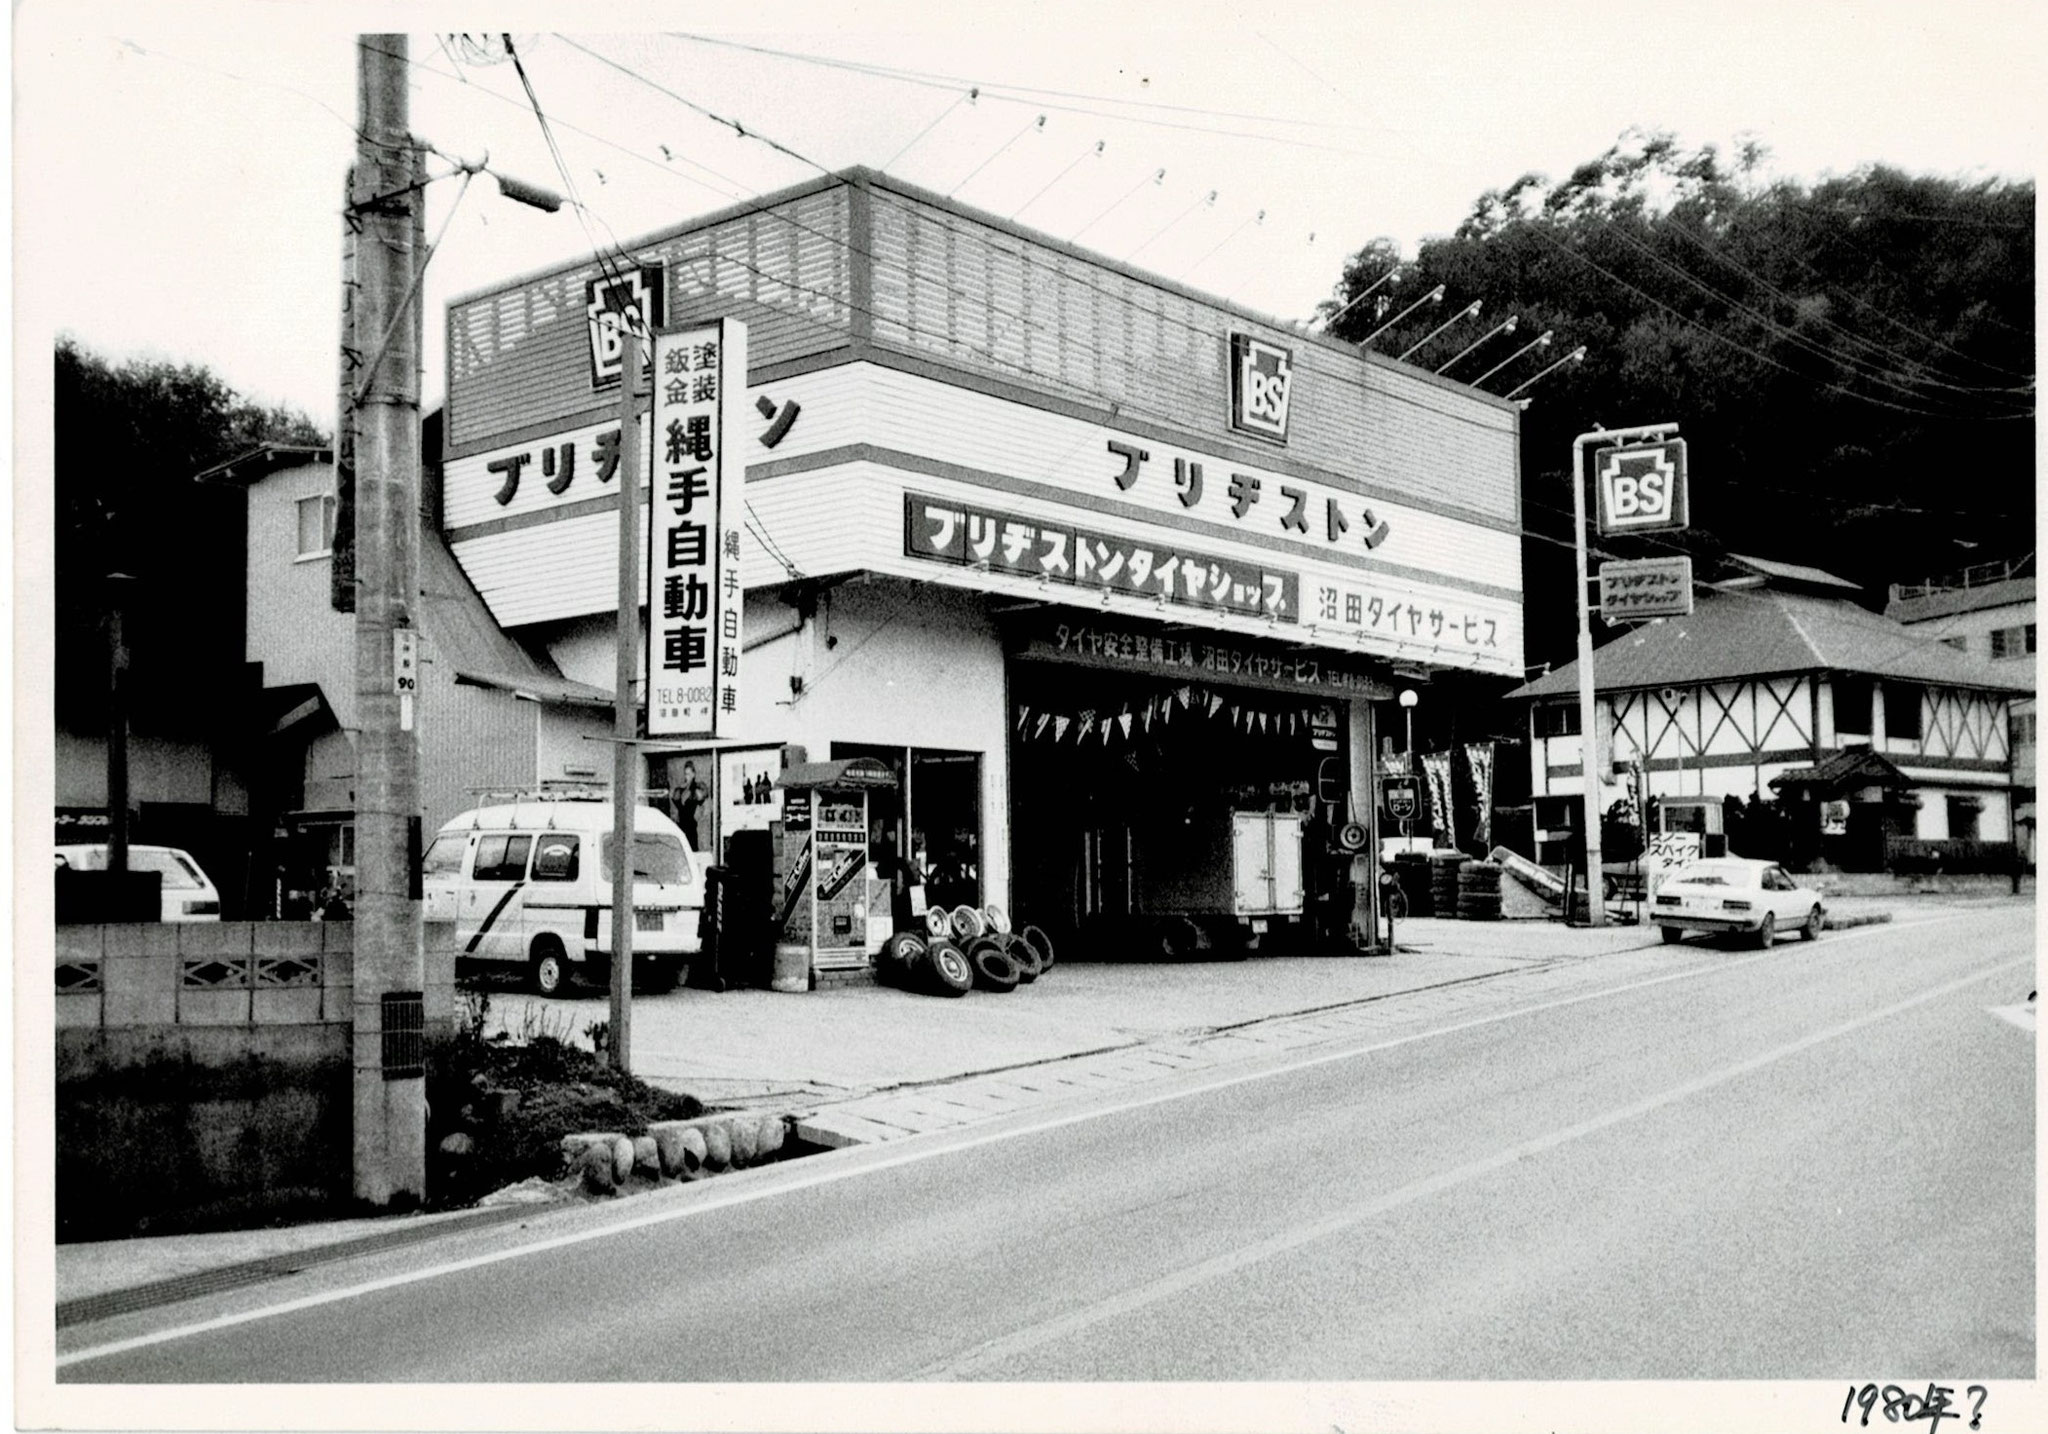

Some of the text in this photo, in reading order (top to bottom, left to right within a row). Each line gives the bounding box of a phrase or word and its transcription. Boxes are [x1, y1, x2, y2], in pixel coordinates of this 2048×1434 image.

[1250, 369, 1284, 421] BS
[1107, 440, 1391, 550] ブリヂストン
[1613, 472, 1666, 516] BS
[663, 414, 714, 673] 縄手自動車
[1319, 586, 1497, 648] 沼田タイヤサービス
[397, 677, 415, 691] 90
